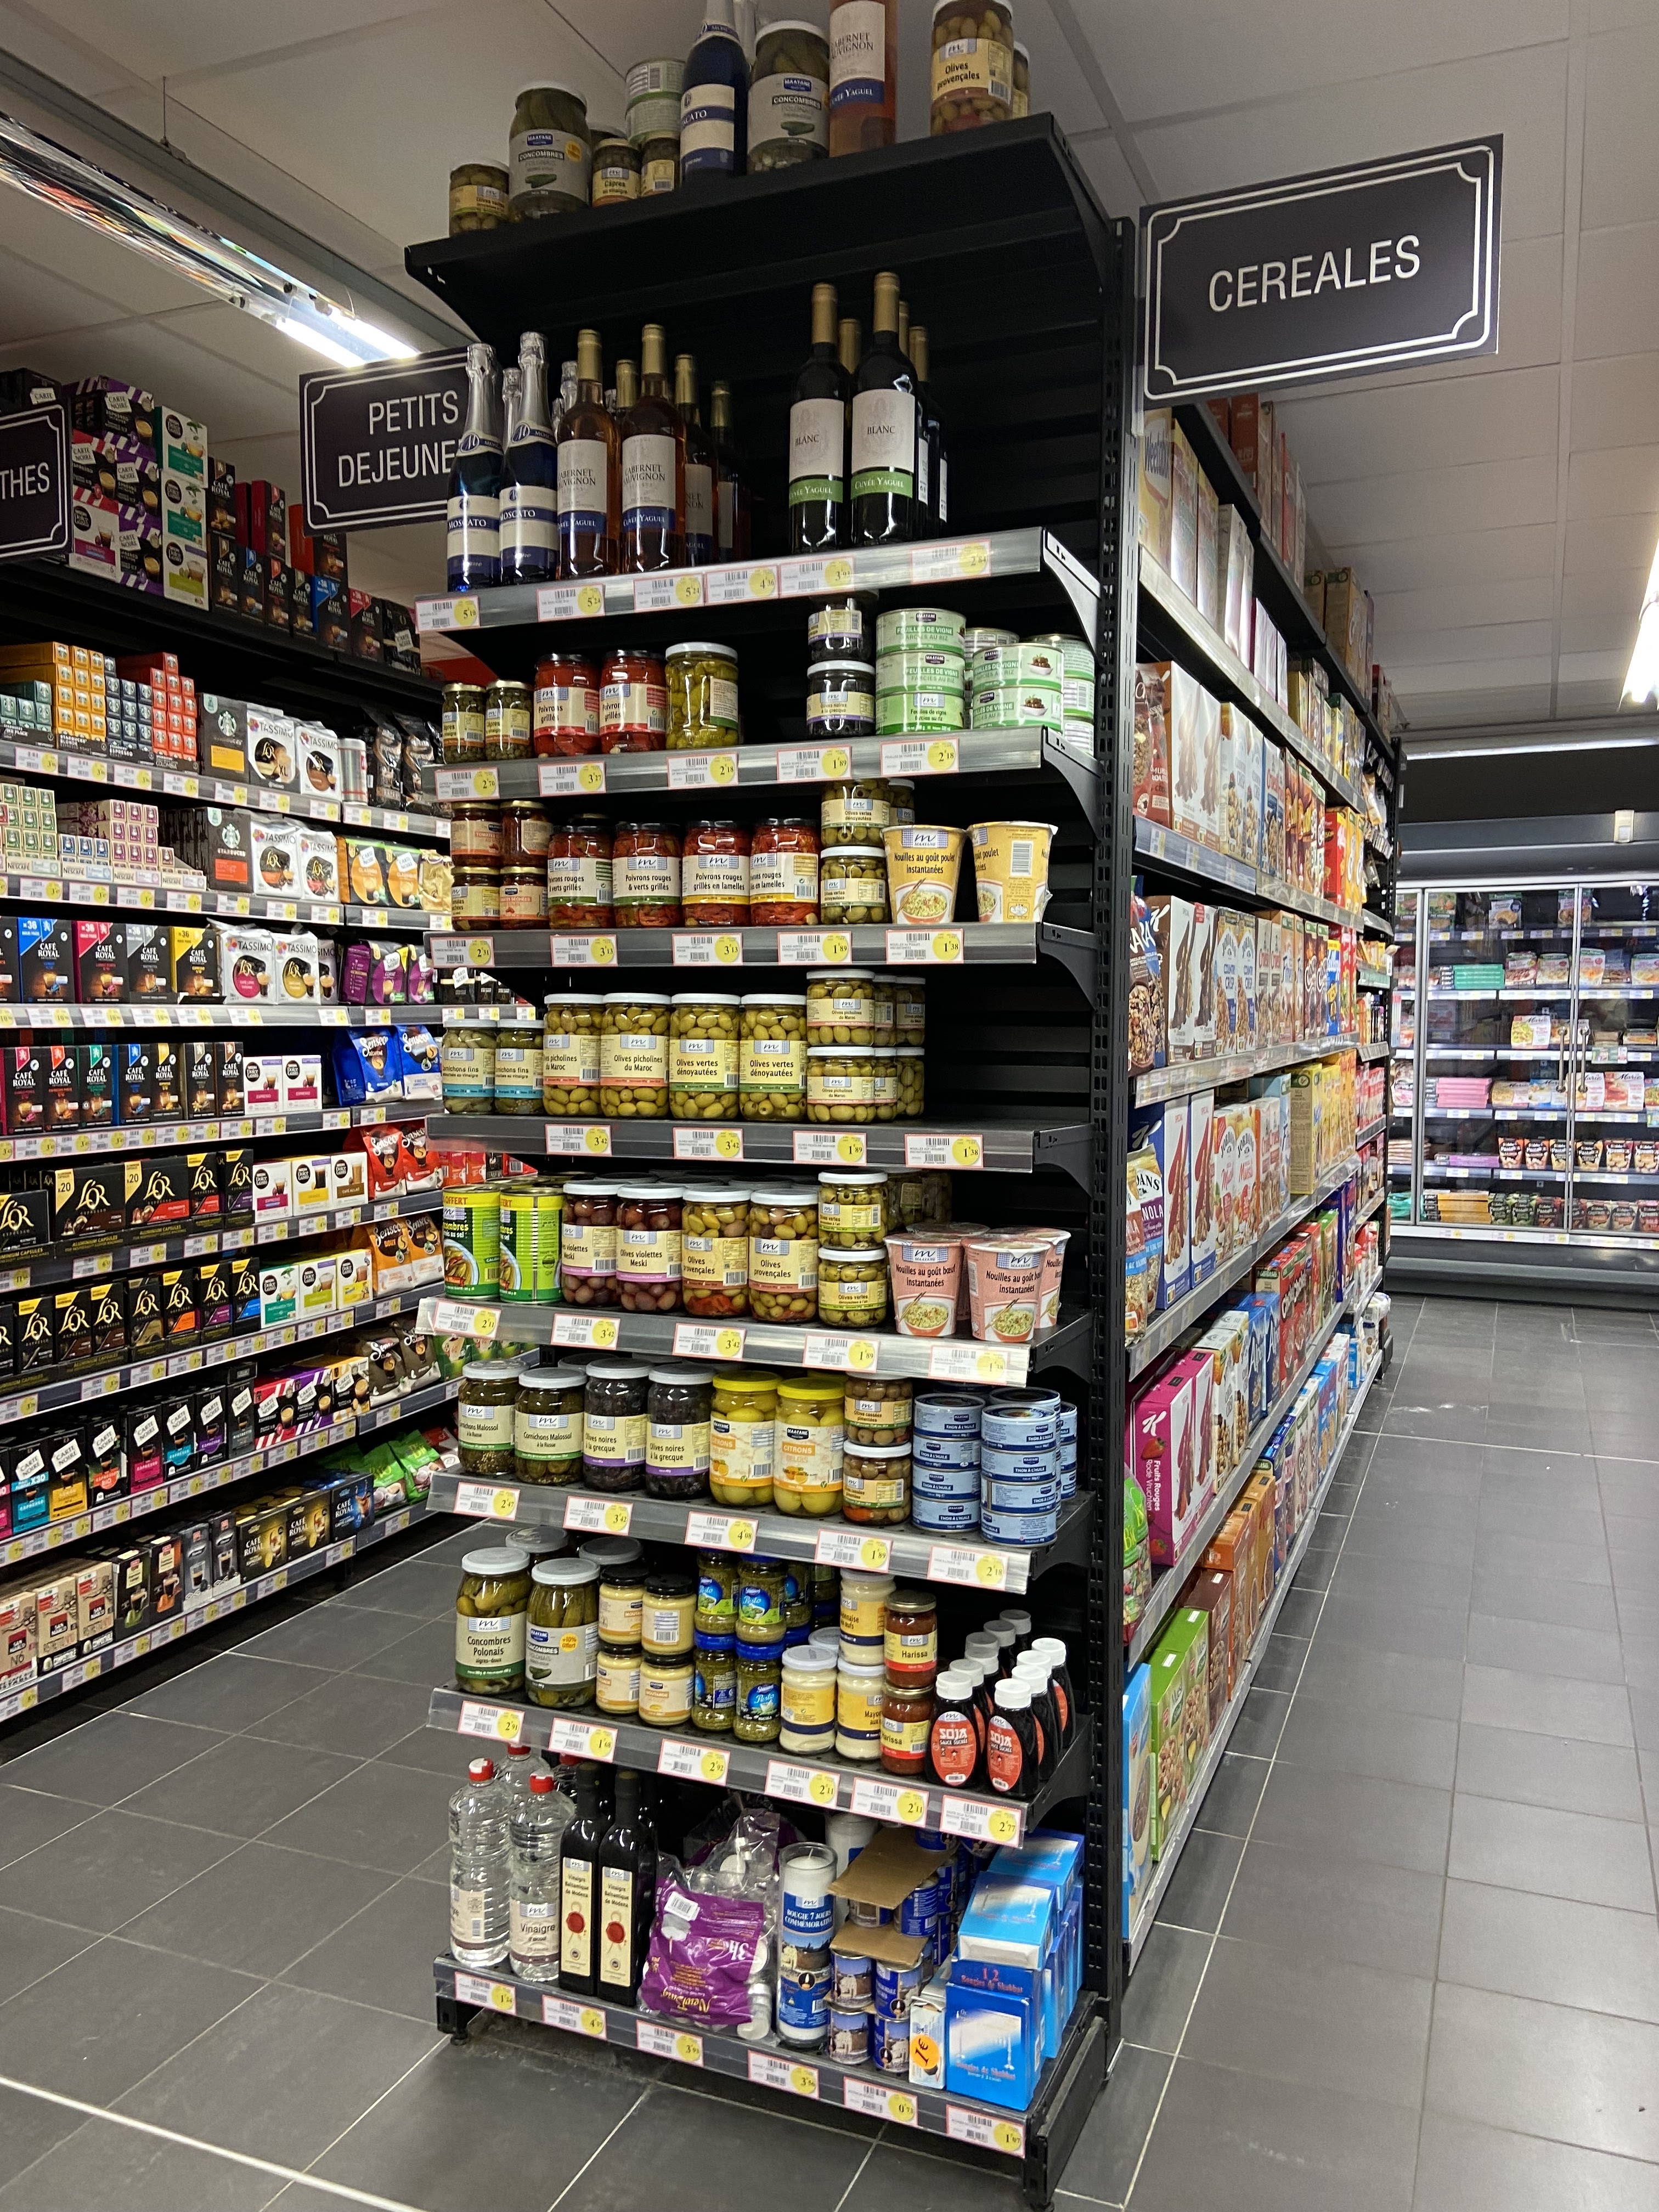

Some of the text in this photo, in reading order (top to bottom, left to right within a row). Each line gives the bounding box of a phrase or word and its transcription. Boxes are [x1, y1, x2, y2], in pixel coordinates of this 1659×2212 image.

[945, 61, 968, 74] Olives
[938, 71, 980, 91] provençales
[1209, 235, 1420, 312] CEREALES
[369, 390, 458, 435] PETITS
[867, 425, 895, 435] BLANC
[795, 434, 819, 445] BLANC
[74, 448, 89, 456] CARTE
[338, 439, 460, 488] DEJEUNE
[625, 464, 662, 474] CABERNET
[0, 462, 50, 499] THES
[623, 472, 665, 484] SAUVIGNON
[212, 486, 230, 498] ROYAL
[500, 509, 535, 521] MOSCATO
[449, 518, 487, 529] MOSCATO
[896, 627, 926, 635] FEUILLES
[935, 627, 953, 635] VIGNE
[944, 668, 959, 677] VIGNE
[259, 723, 294, 737] TASSIMO
[279, 765, 288, 776] XL
[265, 833, 296, 844] TASSIMO
[894, 853, 915, 862] Nouilles
[925, 852, 939, 863] goût
[941, 853, 955, 862] poulet
[982, 848, 998, 859] poulet
[906, 866, 944, 874] instantanées
[563, 884, 581, 892] grillés
[40, 943, 57, 951] CAFÉ
[238, 940, 272, 951] TASSIMO
[287, 943, 317, 953] TASSIMO
[38, 949, 59, 958] ROYAL
[141, 953, 159, 962] ROYAL
[362, 1036, 388, 1057] Senseo
[614, 1054, 663, 1063] Olives picholines
[676, 1058, 694, 1067] Olives
[750, 1059, 794, 1068] Olives vertes
[89, 1068, 104, 1076] CAFÉ
[127, 1066, 142, 1075] CAFÉ
[634, 1064, 653, 1072] Maroc
[677, 1067, 717, 1076] dénoyautées
[751, 1068, 793, 1077] dénoyautées
[15, 1071, 32, 1080] CAFÉ
[51, 1069, 67, 1079] CAFÉ
[87, 1074, 106, 1083] ROYAL
[126, 1073, 145, 1081] ROYAL
[13, 1077, 36, 1087] ROYAL
[49, 1076, 71, 1085] ROYAL
[127, 1174, 139, 1183] x20
[58, 1182, 71, 1193] x20
[445, 1196, 468, 1205] OFFERT
[567, 1244, 588, 1253] violettes
[687, 1256, 706, 1264] Olives
[760, 1260, 781, 1268] Olives
[754, 1269, 791, 1278] provençales
[907, 1277, 944, 1287] instantanées
[1000, 1284, 1034, 1294] instantanées
[1142, 1411, 1166, 1436] K
[96, 1430, 112, 1446] CARTE
[523, 1432, 572, 1441] Cornichons Malossol
[98, 1437, 114, 1452] NOIRE
[592, 1444, 615, 1453] grecque
[650, 1443, 663, 1452] Olives
[783, 1444, 812, 1453] CITRONS
[20, 1455, 38, 1471] CARTE
[21, 1462, 40, 1479] NOIRE
[337, 1499, 351, 1510] CAFÉ
[335, 1506, 354, 1518] ROYAL
[743, 1595, 761, 1605] Pesto
[468, 1635, 511, 1645] Concombres
[473, 1647, 504, 1656] Polonais
[902, 1650, 928, 1658] Harissa
[755, 1694, 774, 1704] Pesto
[940, 1728, 967, 1739] SOJA
[991, 1730, 1012, 1747] SOJA
[787, 1909, 808, 1918] BOUGIE
[810, 1911, 814, 1920] 7
[521, 1923, 555, 1933] Vinaigre
